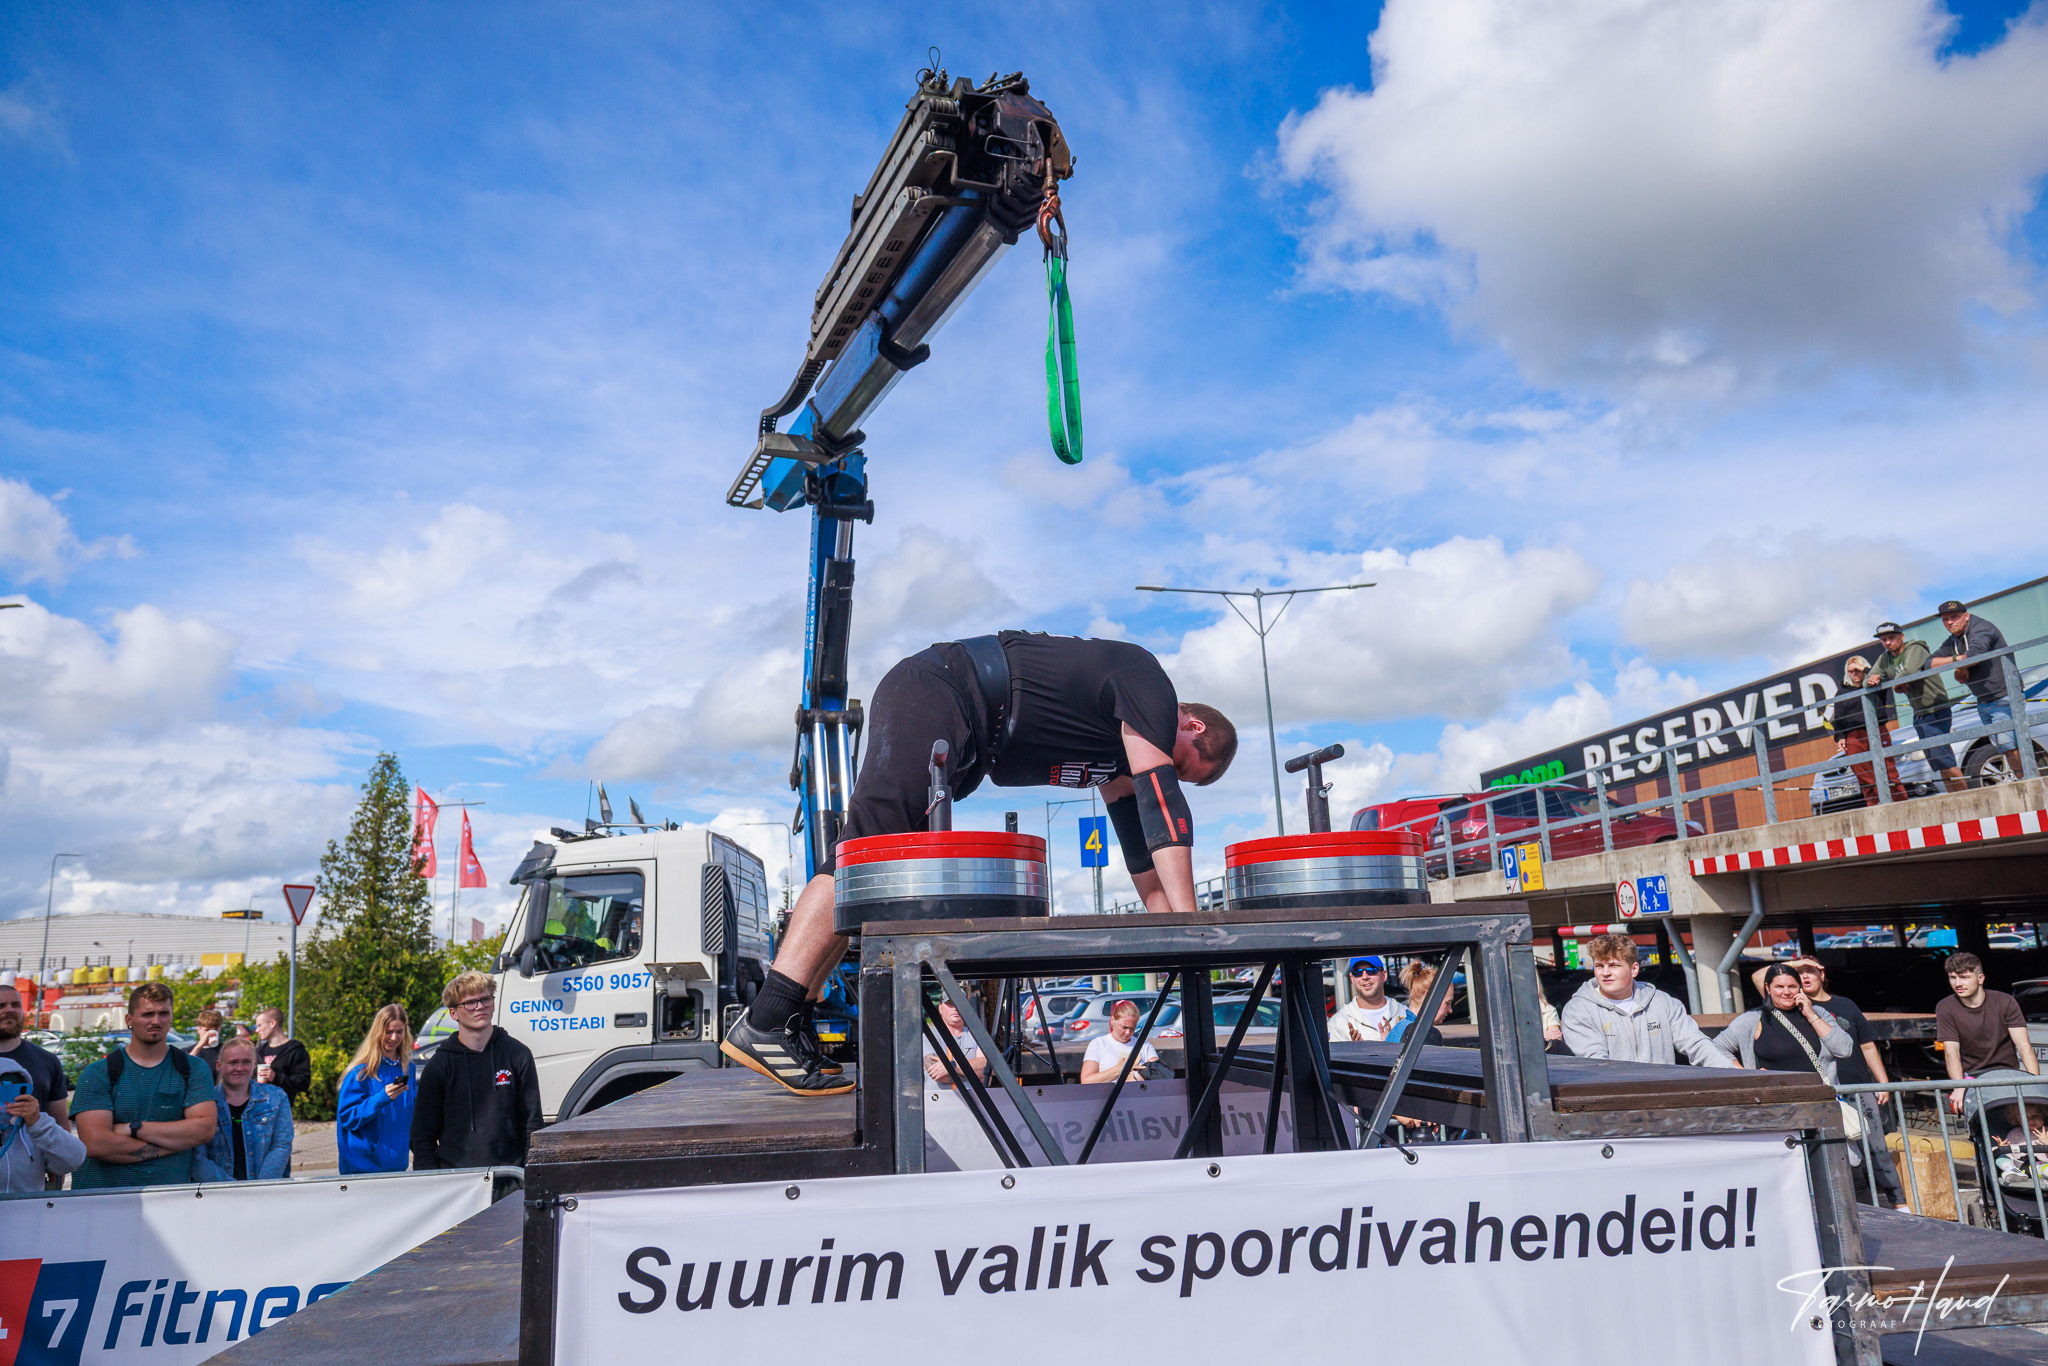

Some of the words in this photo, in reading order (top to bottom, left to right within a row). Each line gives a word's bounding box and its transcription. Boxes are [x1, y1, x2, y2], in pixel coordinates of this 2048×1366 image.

[1583, 673, 1838, 788] RESERVED
[1085, 829, 1102, 853] 4
[1505, 852, 1513, 876] P
[562, 976, 604, 993] 5560
[610, 972, 652, 989] 9057
[510, 999, 563, 1013] GENNO
[530, 1016, 605, 1031] TÕSTEABI
[618, 1238, 904, 1314] Suurim
[934, 1223, 1114, 1296] valik
[1135, 1187, 1758, 1298] spordivahendeid!
[103, 1278, 353, 1350] Fitne
